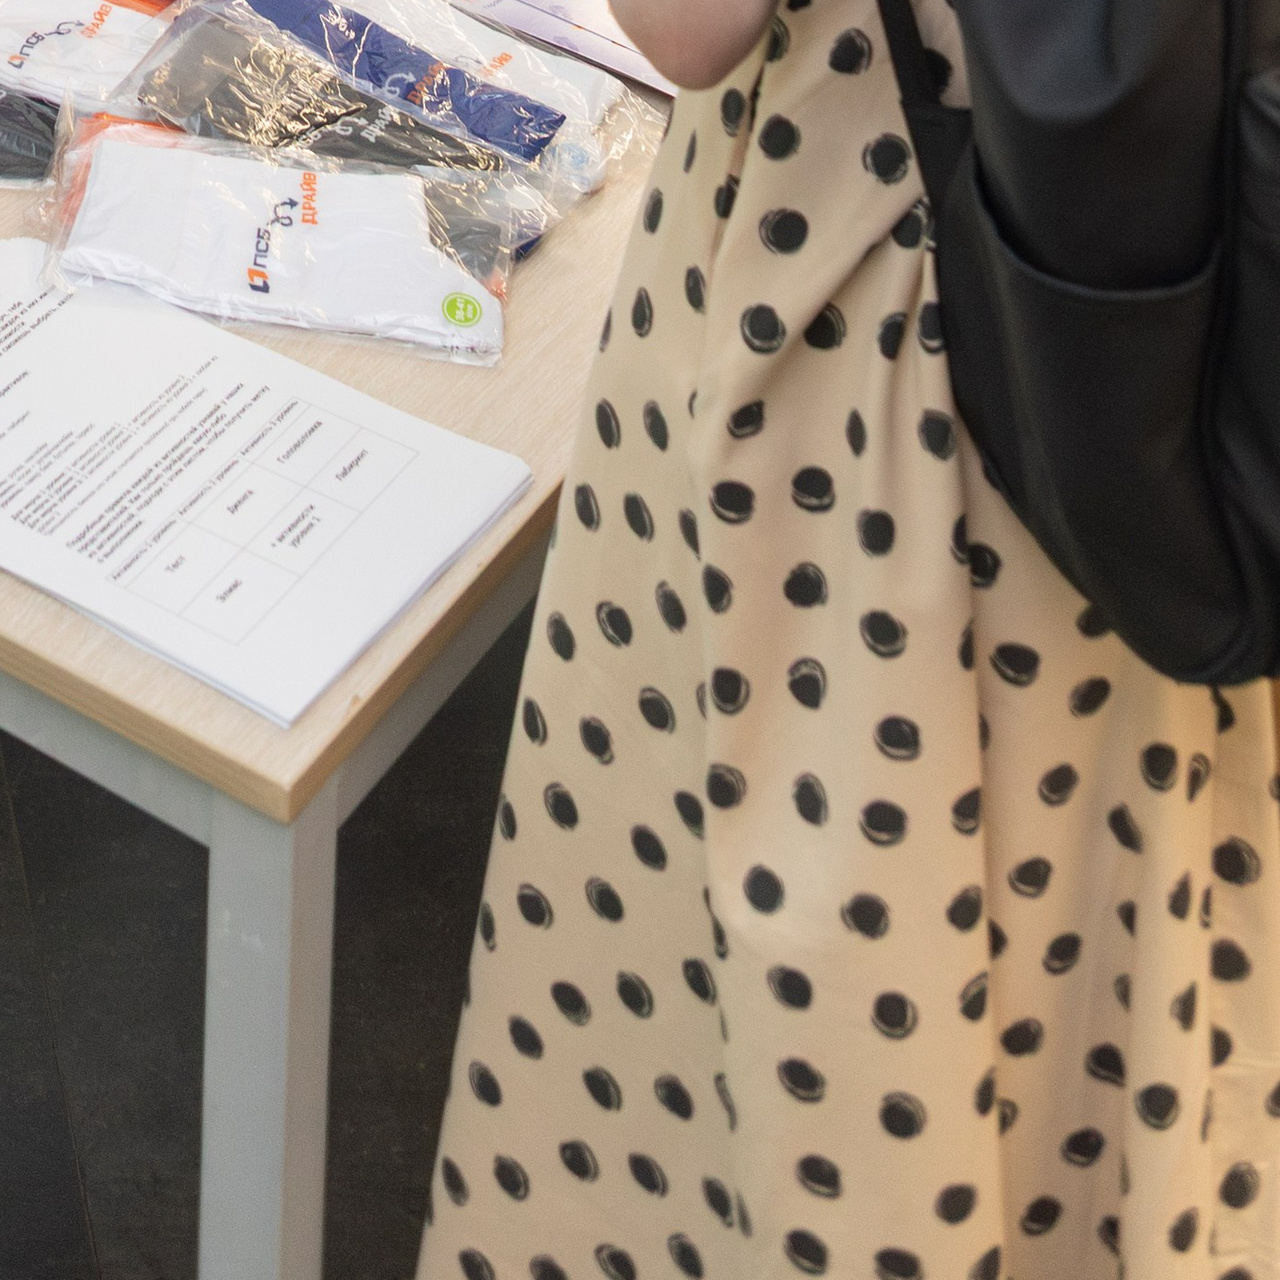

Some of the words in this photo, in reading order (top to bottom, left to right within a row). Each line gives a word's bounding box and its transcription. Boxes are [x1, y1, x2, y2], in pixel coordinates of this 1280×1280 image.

[20, 31, 45, 57] ПСБ
[301, 171, 318, 225] ДРАЙВ
[253, 228, 271, 269] ПСБ
